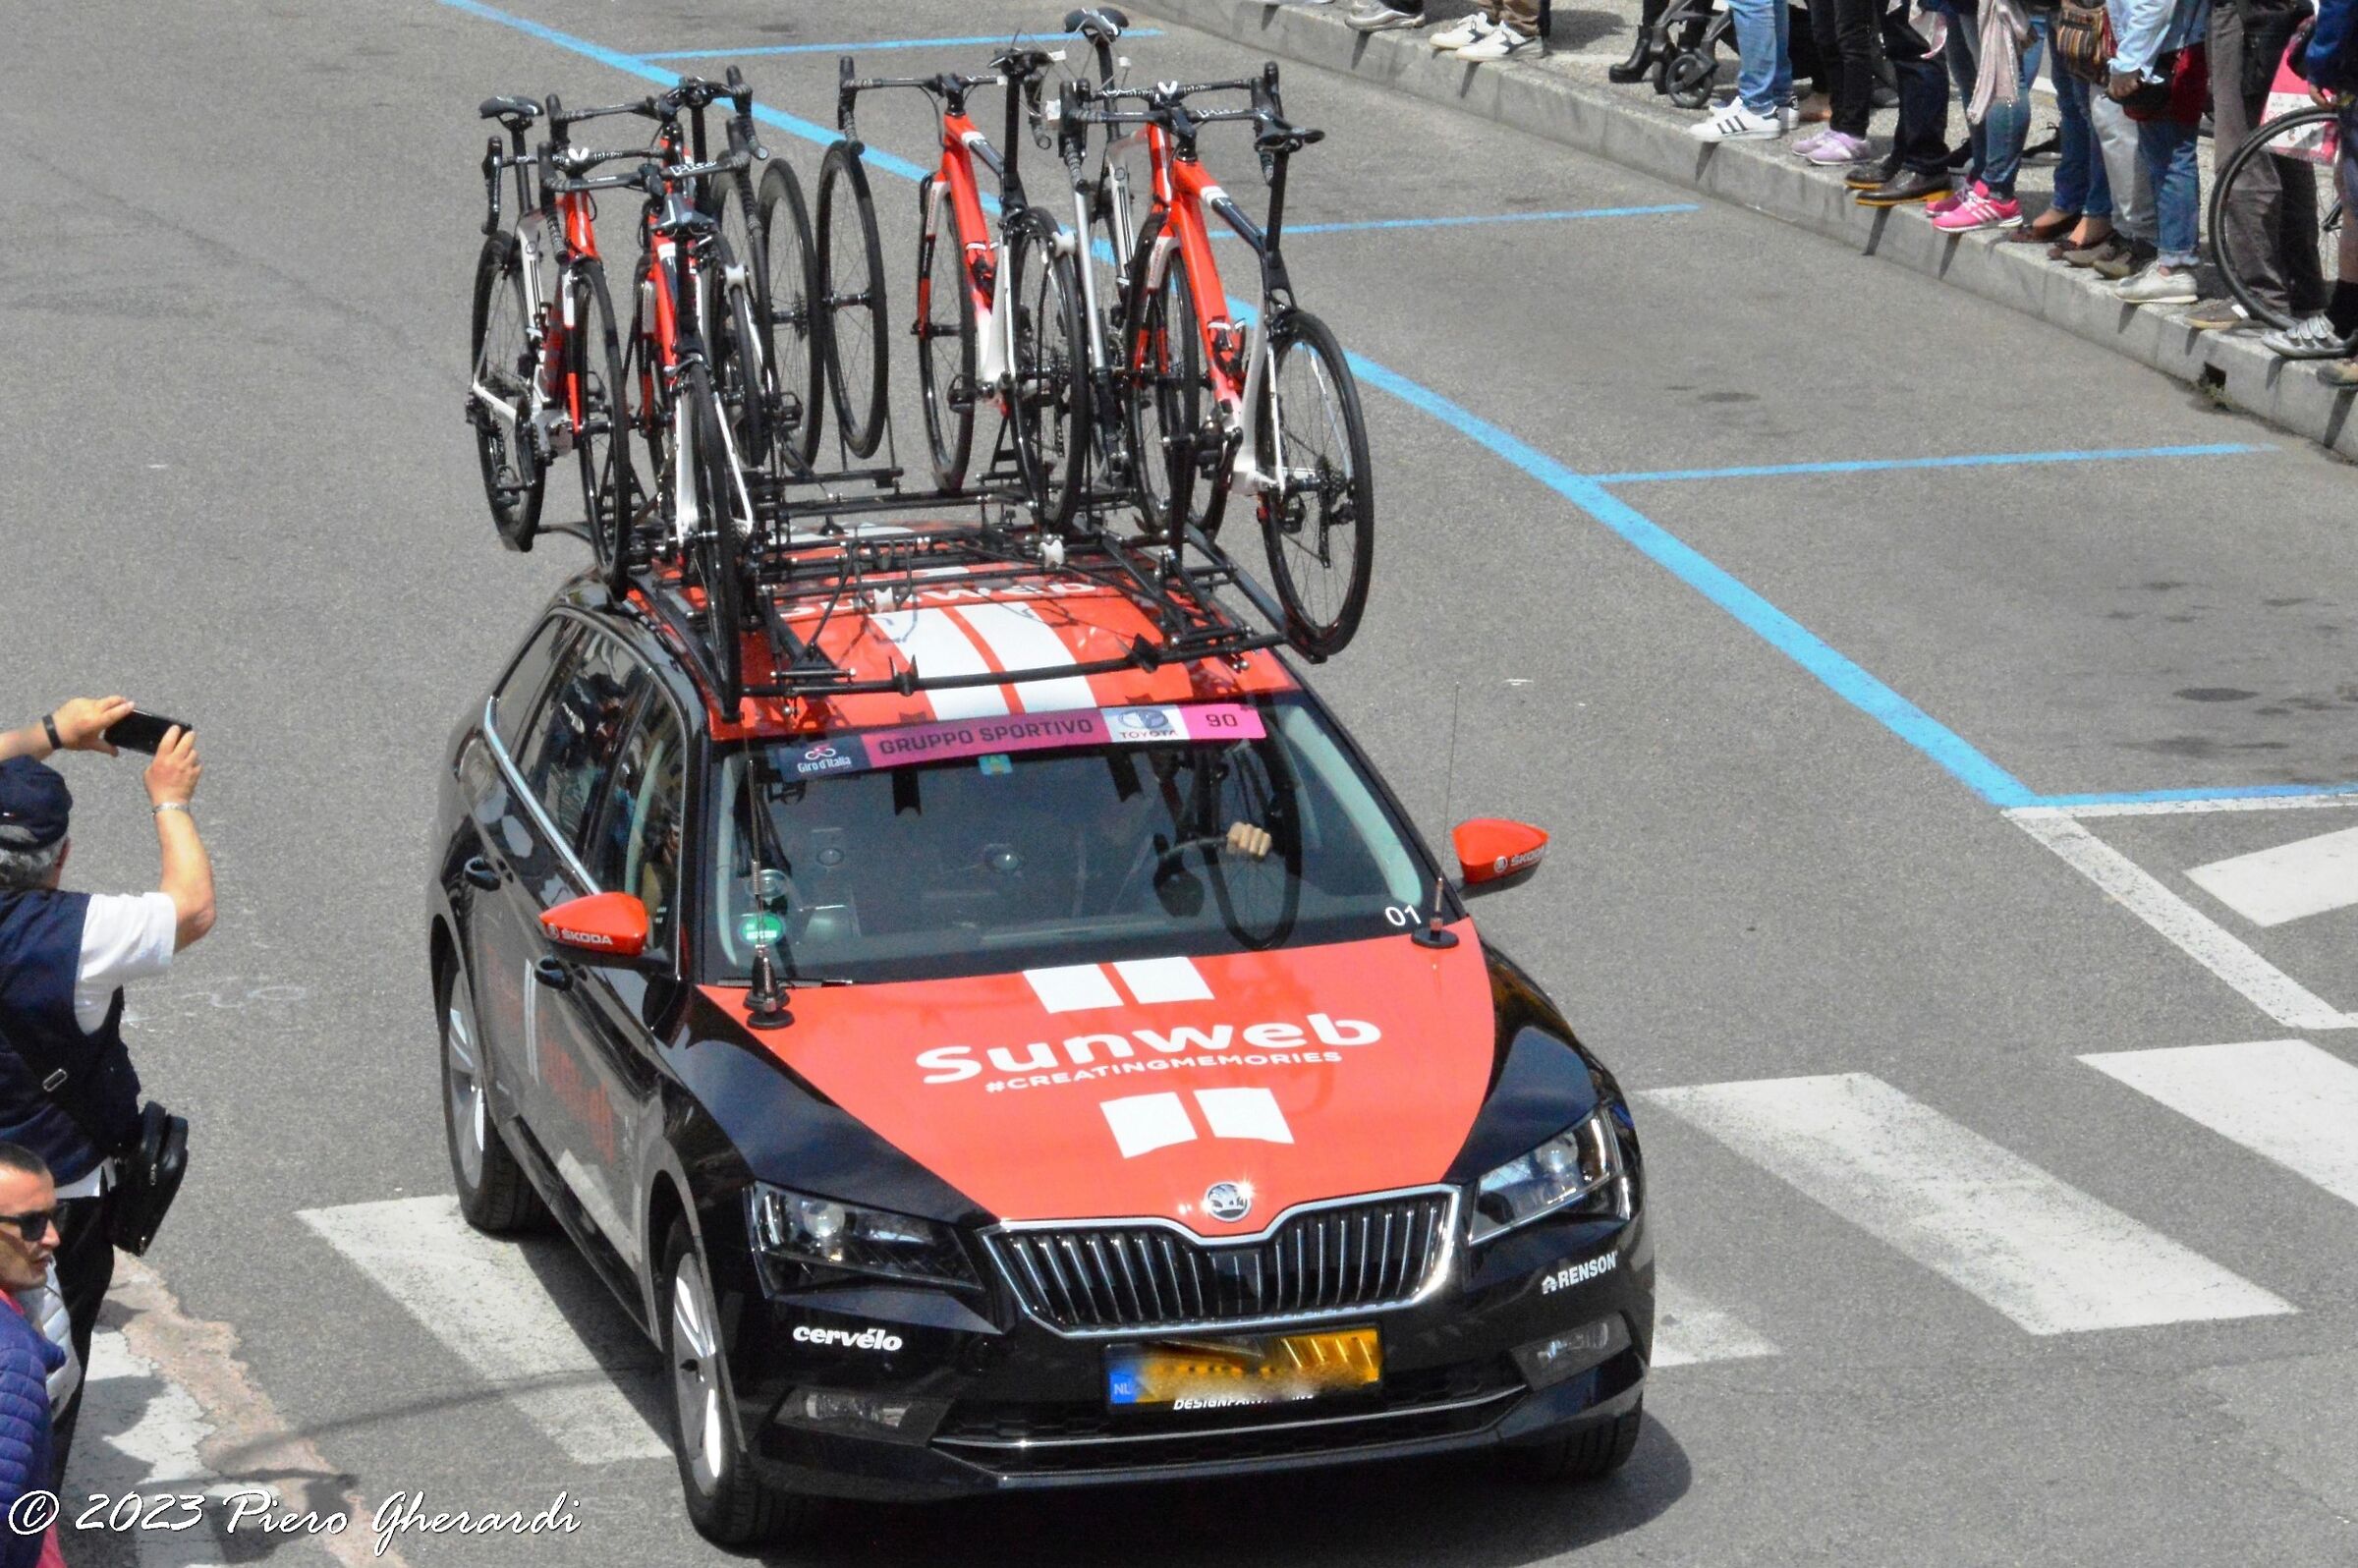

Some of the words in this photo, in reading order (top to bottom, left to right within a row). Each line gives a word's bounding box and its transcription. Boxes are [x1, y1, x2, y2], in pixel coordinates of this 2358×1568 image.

[1206, 713, 1238, 728] 90
[878, 729, 975, 755] GRUPPO
[979, 718, 1094, 742] SPORTIVO
[1119, 730, 1178, 739] TOYOTA
[797, 760, 819, 773] Giro
[1384, 904, 1422, 926] 01
[915, 1012, 1382, 1085] Sunweb
[984, 1051, 1343, 1093] #CREATINGMEMORIES
[1557, 1251, 1616, 1289] RENSON
[792, 1325, 903, 1352] cervélo
[1113, 1382, 1132, 1395] NL
